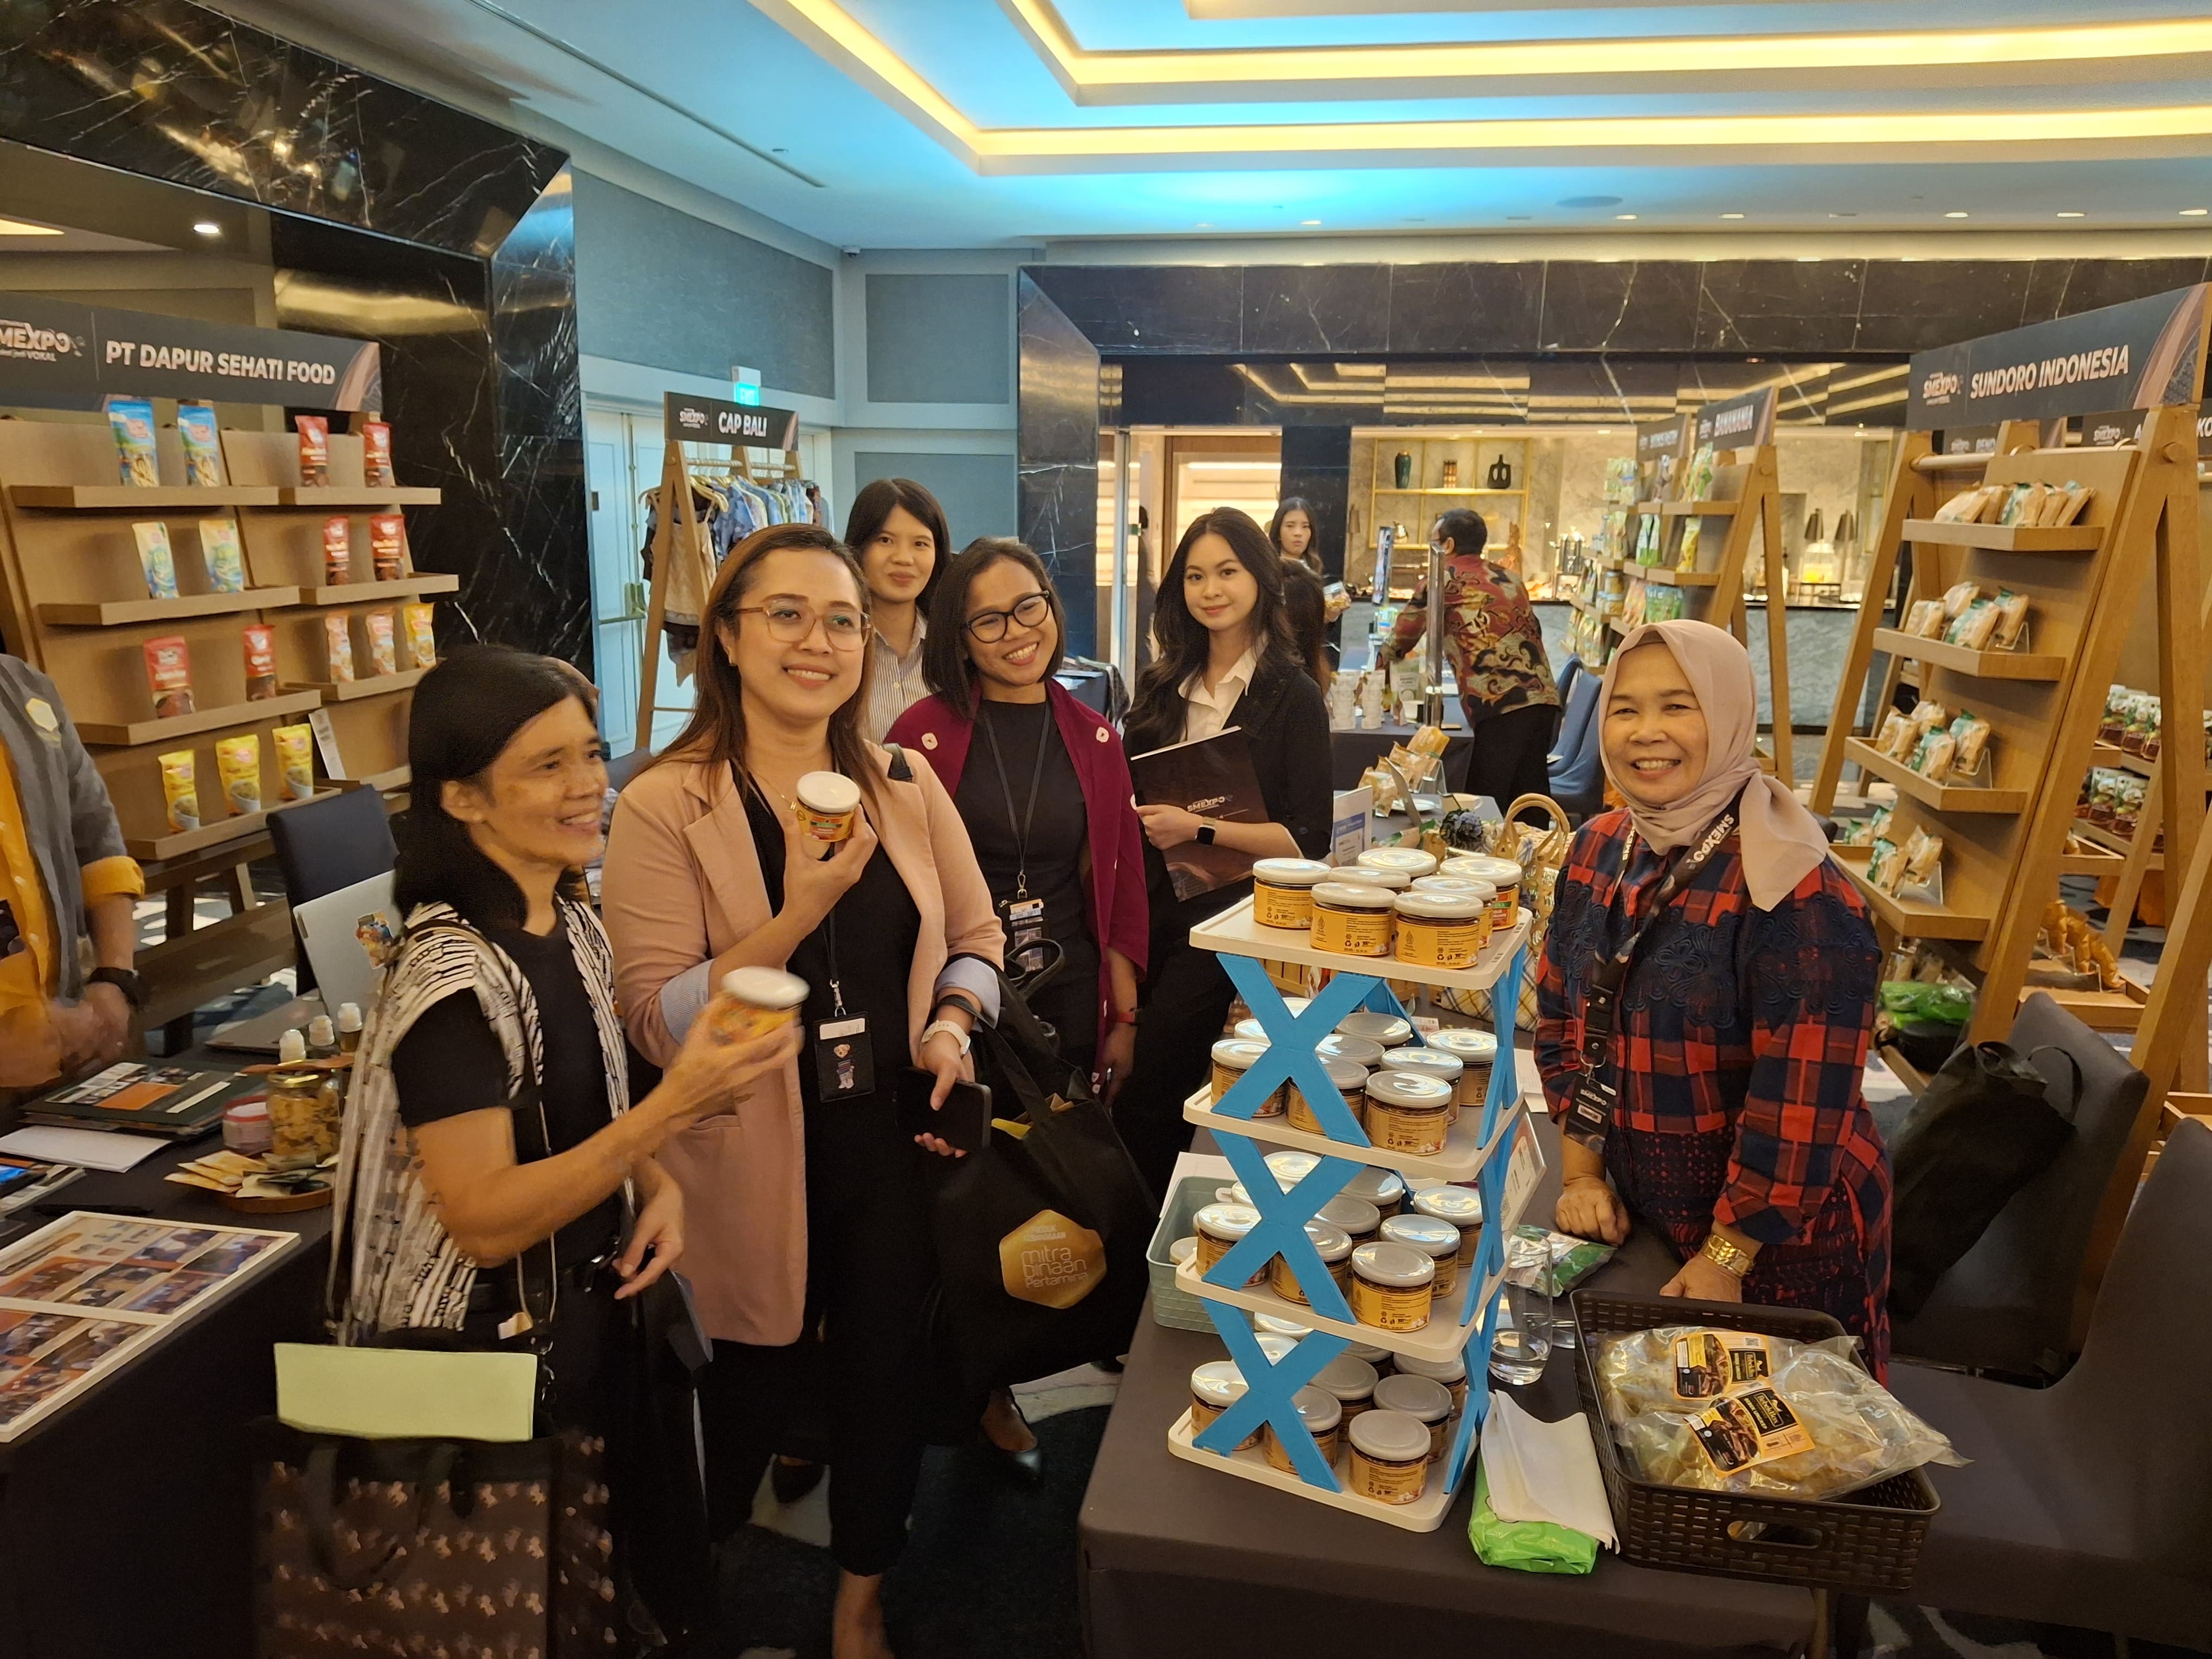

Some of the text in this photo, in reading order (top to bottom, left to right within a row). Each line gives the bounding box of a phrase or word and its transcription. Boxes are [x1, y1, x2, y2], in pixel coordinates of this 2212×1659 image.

[0, 325, 70, 352] MEXPO
[106, 340, 336, 385] PT DAPUR SEHATI FOOD
[1970, 344, 2129, 399] SUNDORO INDONESIA
[1923, 374, 1957, 398] SMEXPO
[718, 411, 767, 436] CAP BALI
[1187, 796, 1225, 812] SMEXPO
[1693, 813, 1734, 863] SMEXPO
[1021, 1245, 1071, 1263] mitra
[1024, 1259, 1086, 1278] binaan
